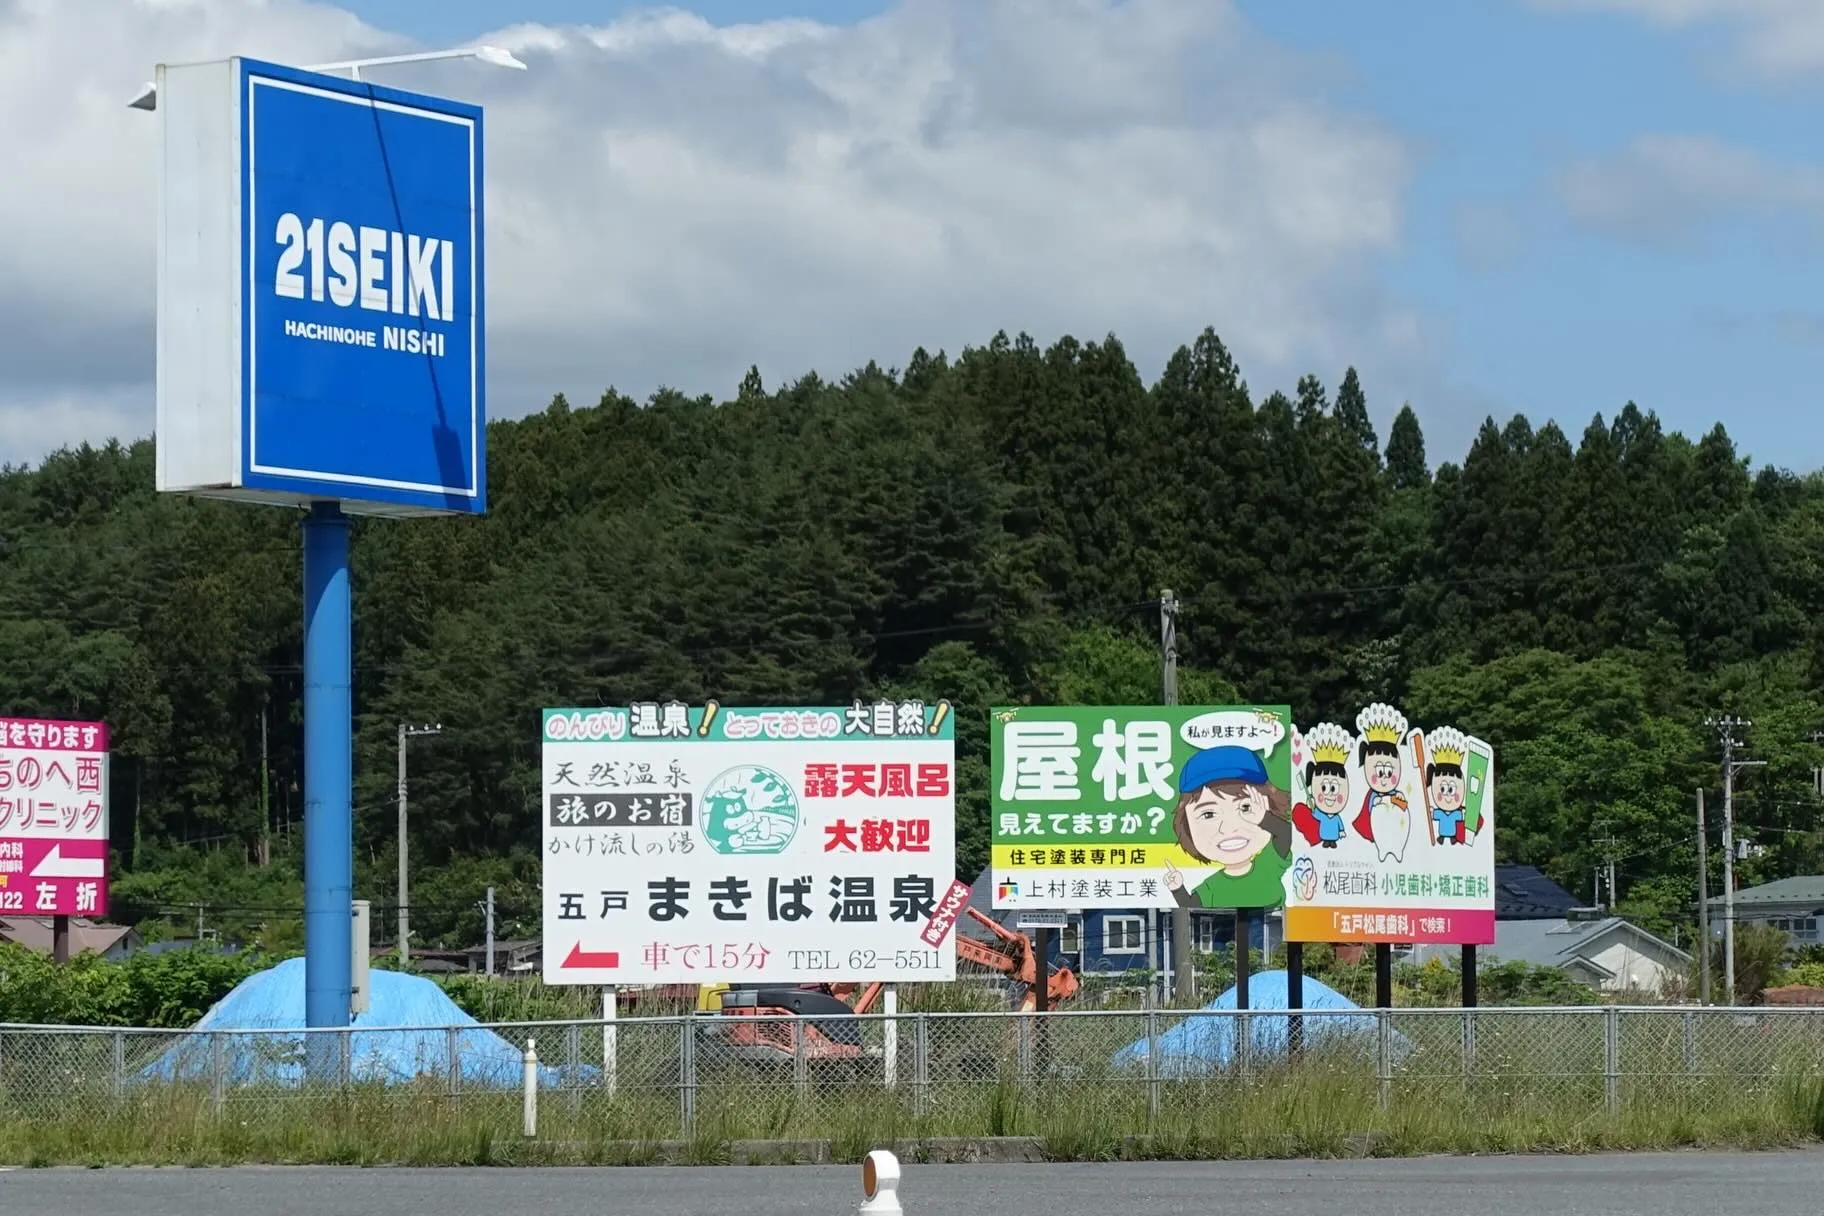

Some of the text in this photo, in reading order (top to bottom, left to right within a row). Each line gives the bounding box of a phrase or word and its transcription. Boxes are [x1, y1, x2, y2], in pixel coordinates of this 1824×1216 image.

[275, 212, 454, 322] 21SEIKI
[285, 319, 445, 357] HACHINOHE NISHI
[550, 759, 691, 788] 天然温泉
[1000, 718, 1175, 801] 屋根
[804, 763, 950, 798] 露天風呂
[556, 794, 687, 825] 旅のお宿
[998, 806, 1166, 836] 見えてますか?
[548, 832, 696, 857] かけ流しの湯
[824, 818, 931, 853] 大歓迎
[1009, 848, 1147, 866] 住宅塗装専門店
[36, 881, 97, 911] 左折
[557, 874, 937, 924] 五戸 まきば温泉
[1025, 879, 1159, 898] 上村塗装工業
[641, 942, 771, 970] 車で15分
[788, 950, 840, 970] TEL
[848, 950, 942, 970] 62-5511
